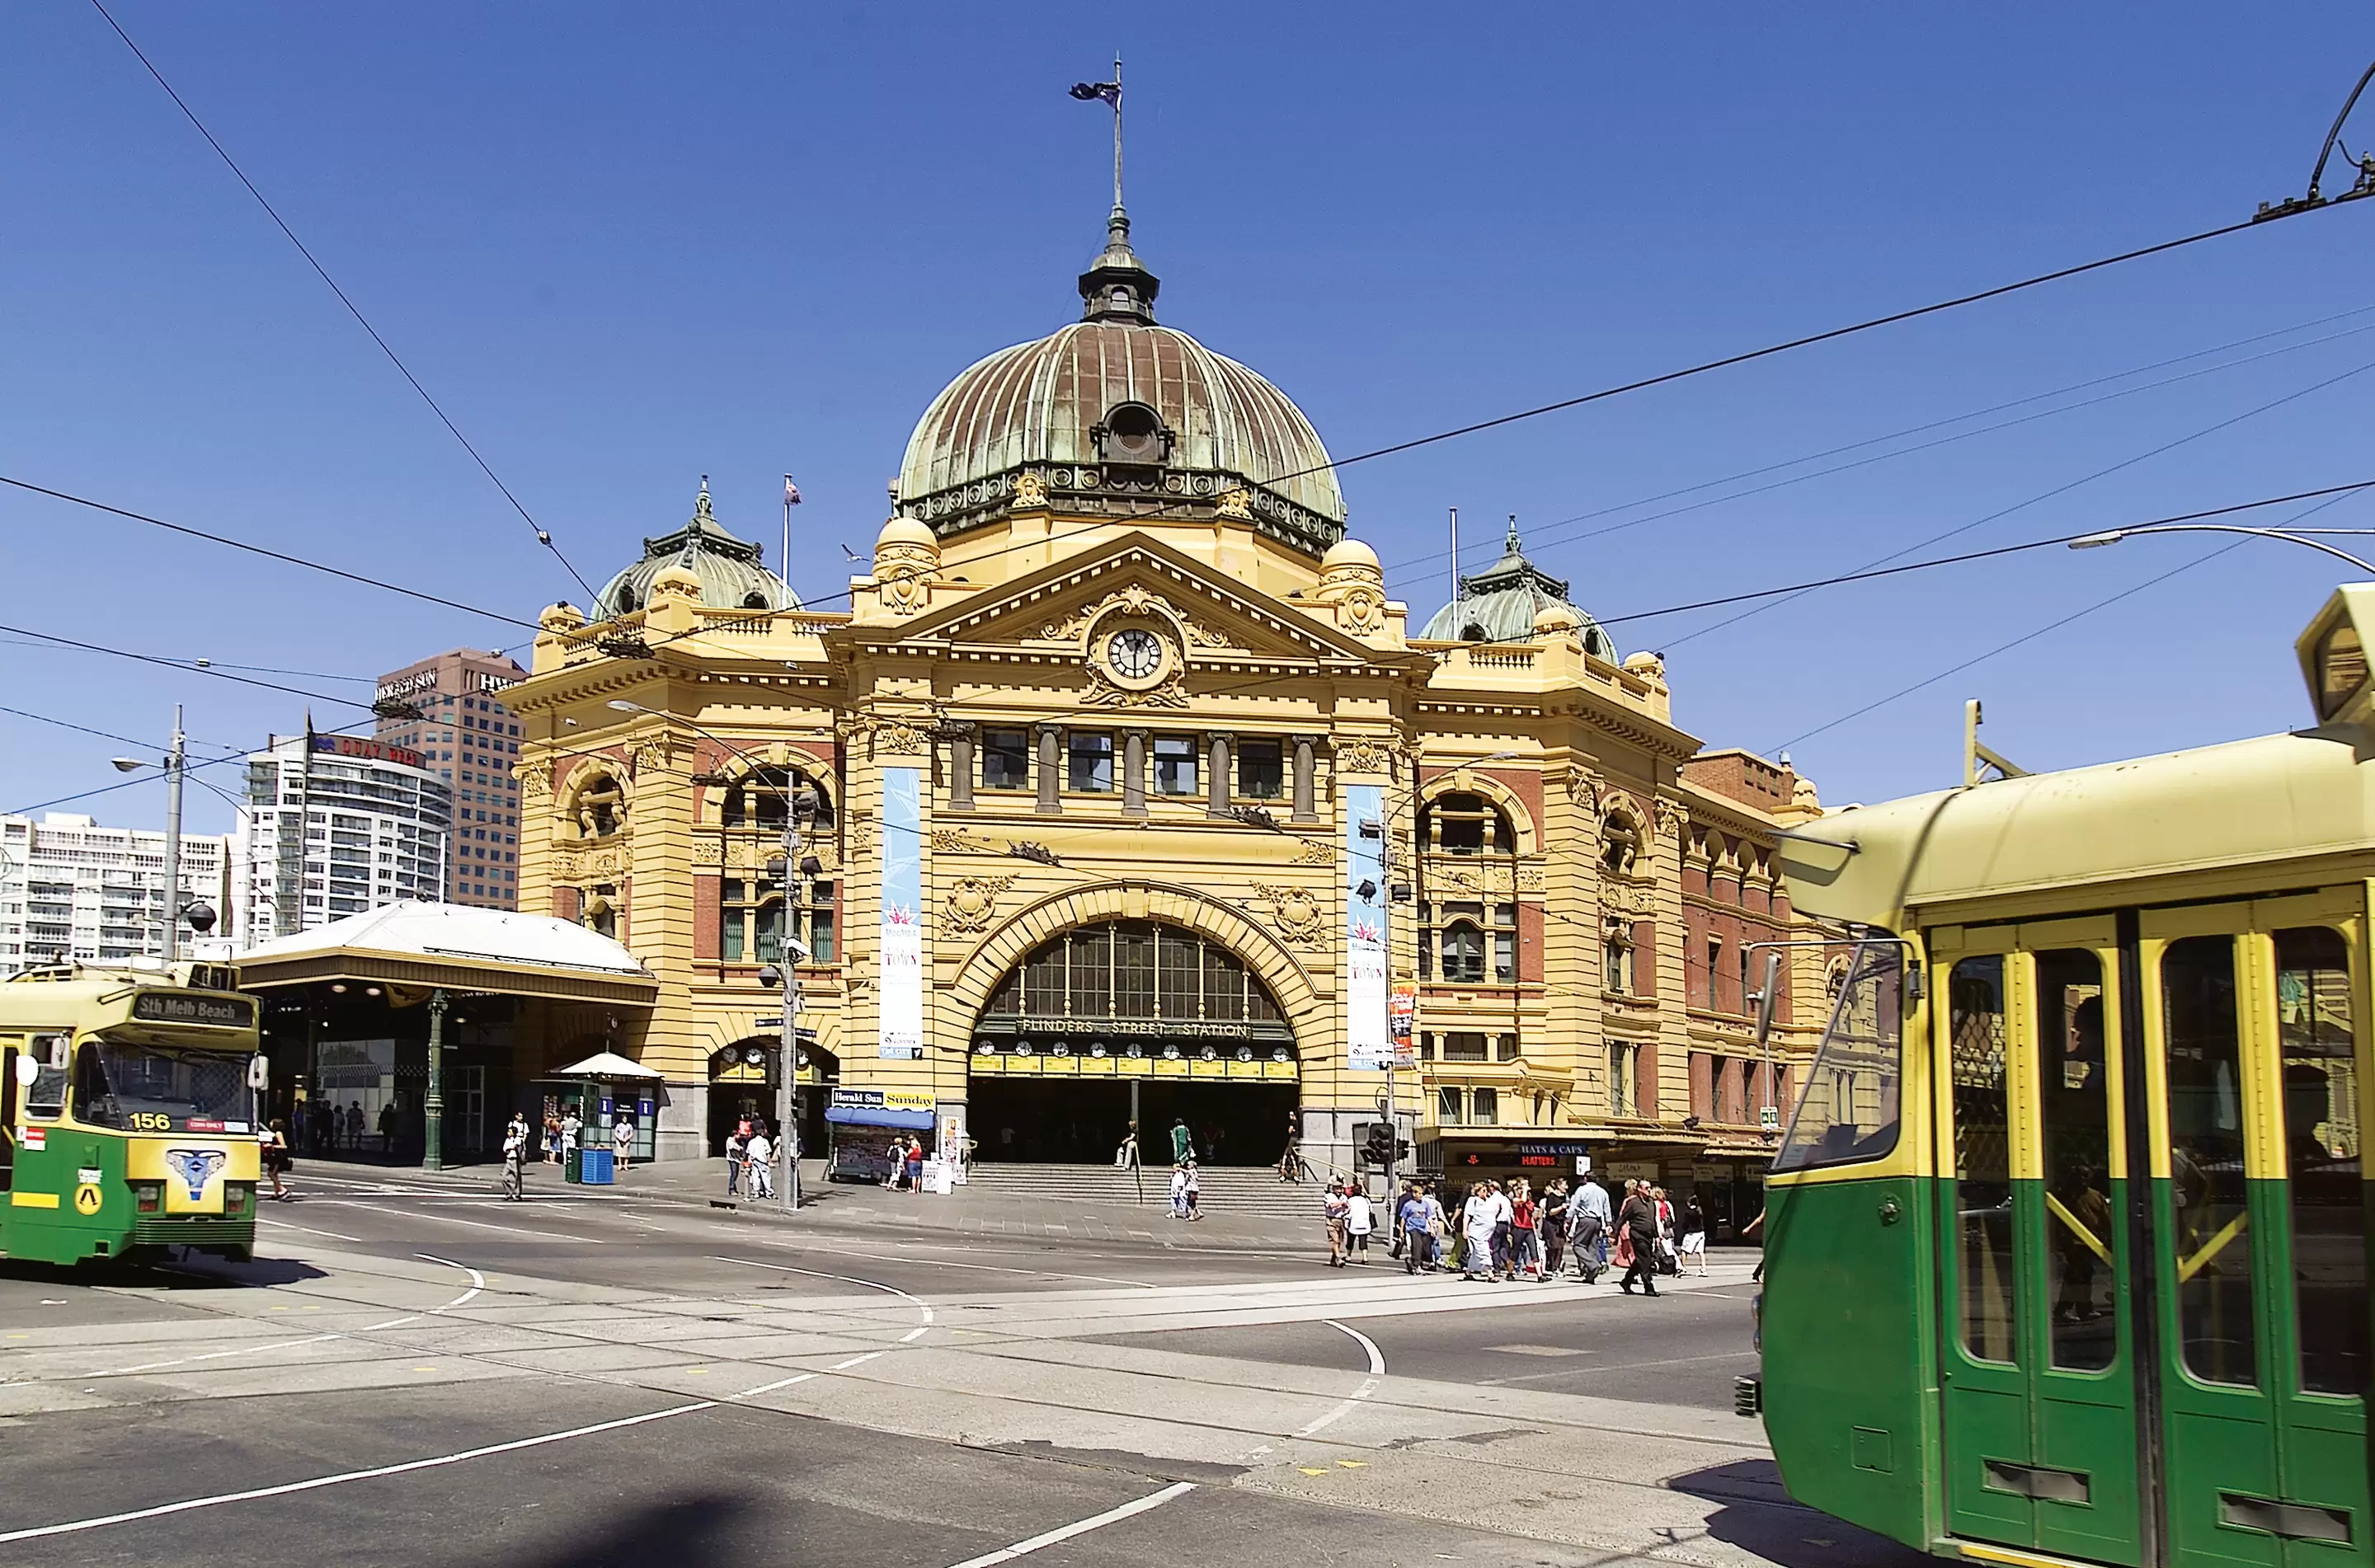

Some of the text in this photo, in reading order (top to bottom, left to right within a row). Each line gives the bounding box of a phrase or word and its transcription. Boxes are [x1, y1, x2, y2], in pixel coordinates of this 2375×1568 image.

[342, 740, 381, 758] QUAY
[884, 953, 917, 966] TOWN
[1352, 967, 1382, 979] TOWN
[139, 997, 235, 1019] Sth Melb Beach
[1023, 1020, 1248, 1036] FLINDERS STREET STATION
[835, 1092, 934, 1106] Herald Sun Sunday
[129, 1113, 171, 1129] 156
[1521, 1145, 1583, 1154] HATS & CAPS
[1521, 1155, 1555, 1166] HATTERS
